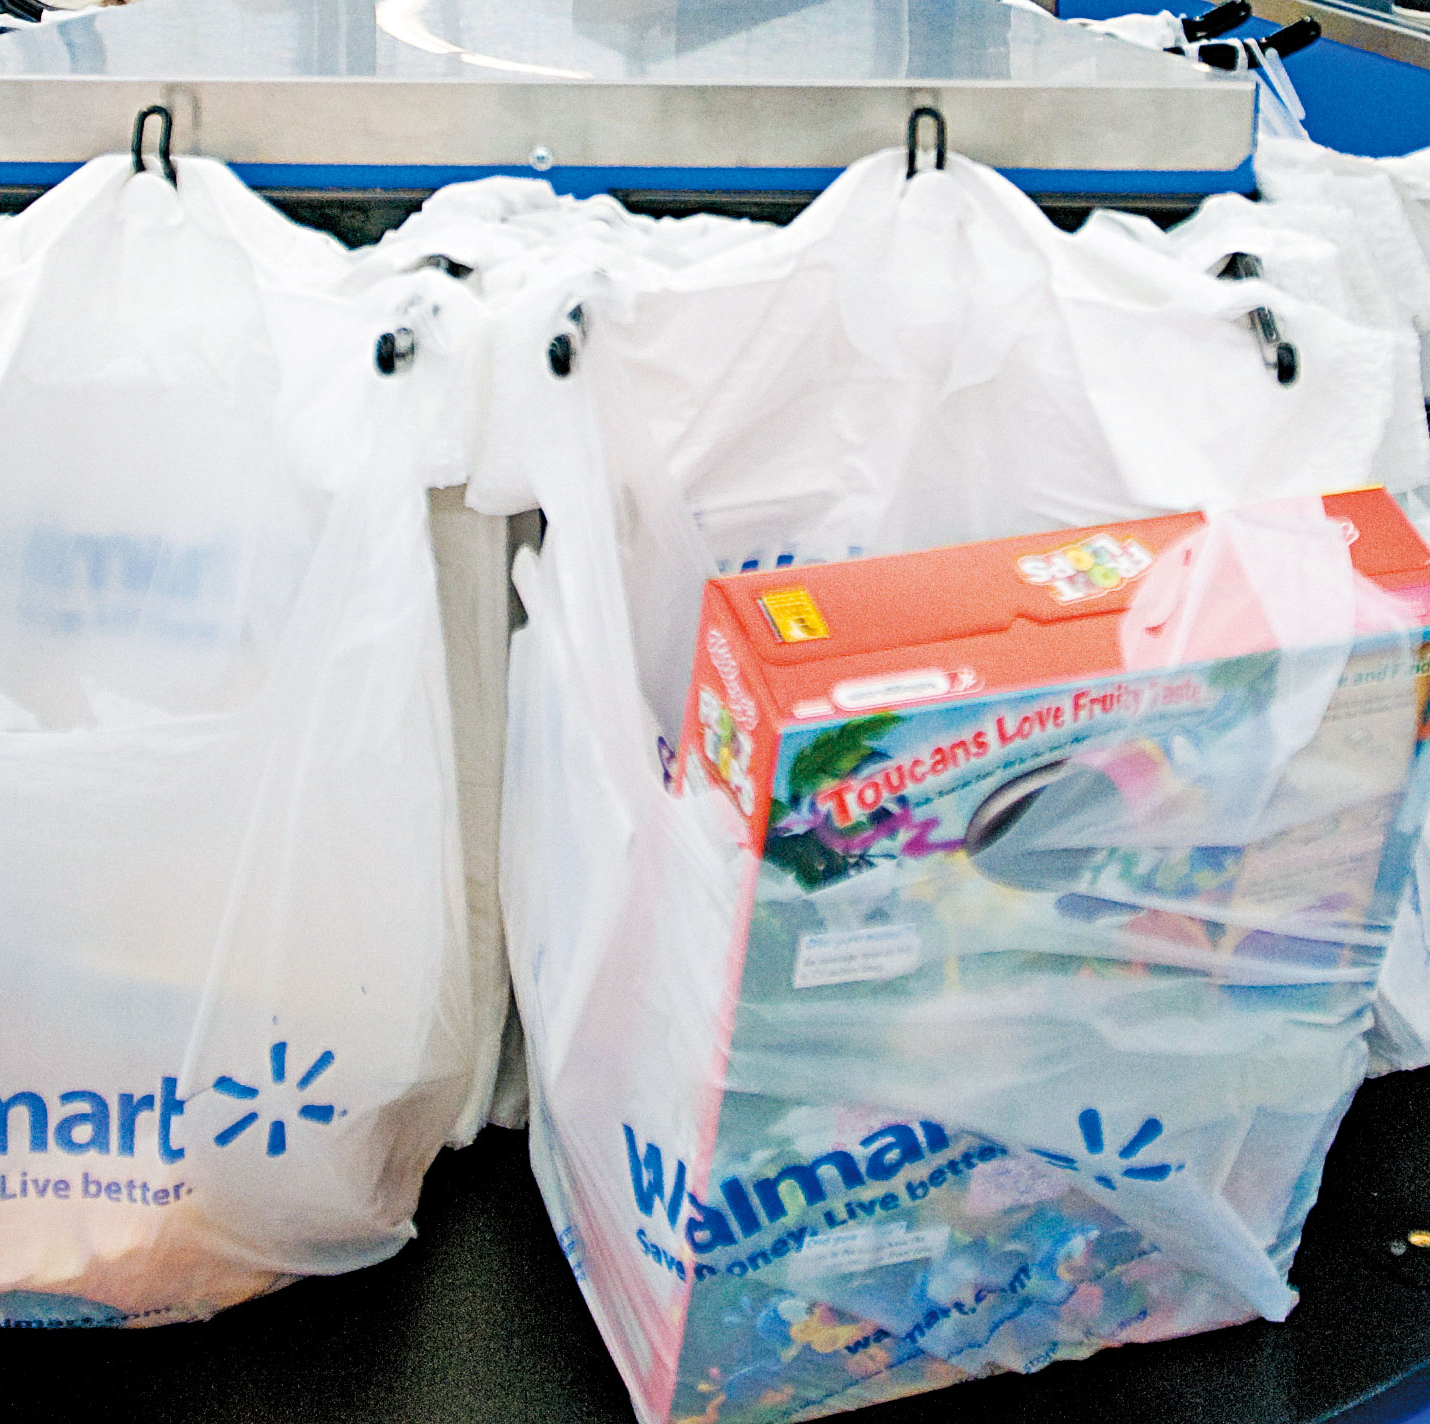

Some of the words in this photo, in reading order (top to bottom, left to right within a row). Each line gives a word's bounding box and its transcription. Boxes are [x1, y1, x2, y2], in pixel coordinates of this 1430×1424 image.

[817, 730, 989, 828] Toucans
[995, 705, 1067, 749] Love
[80, 1172, 194, 1208] better.
[621, 1119, 950, 1256] Walmar
[636, 1228, 687, 1282] Save
[823, 1189, 901, 1230] Live
